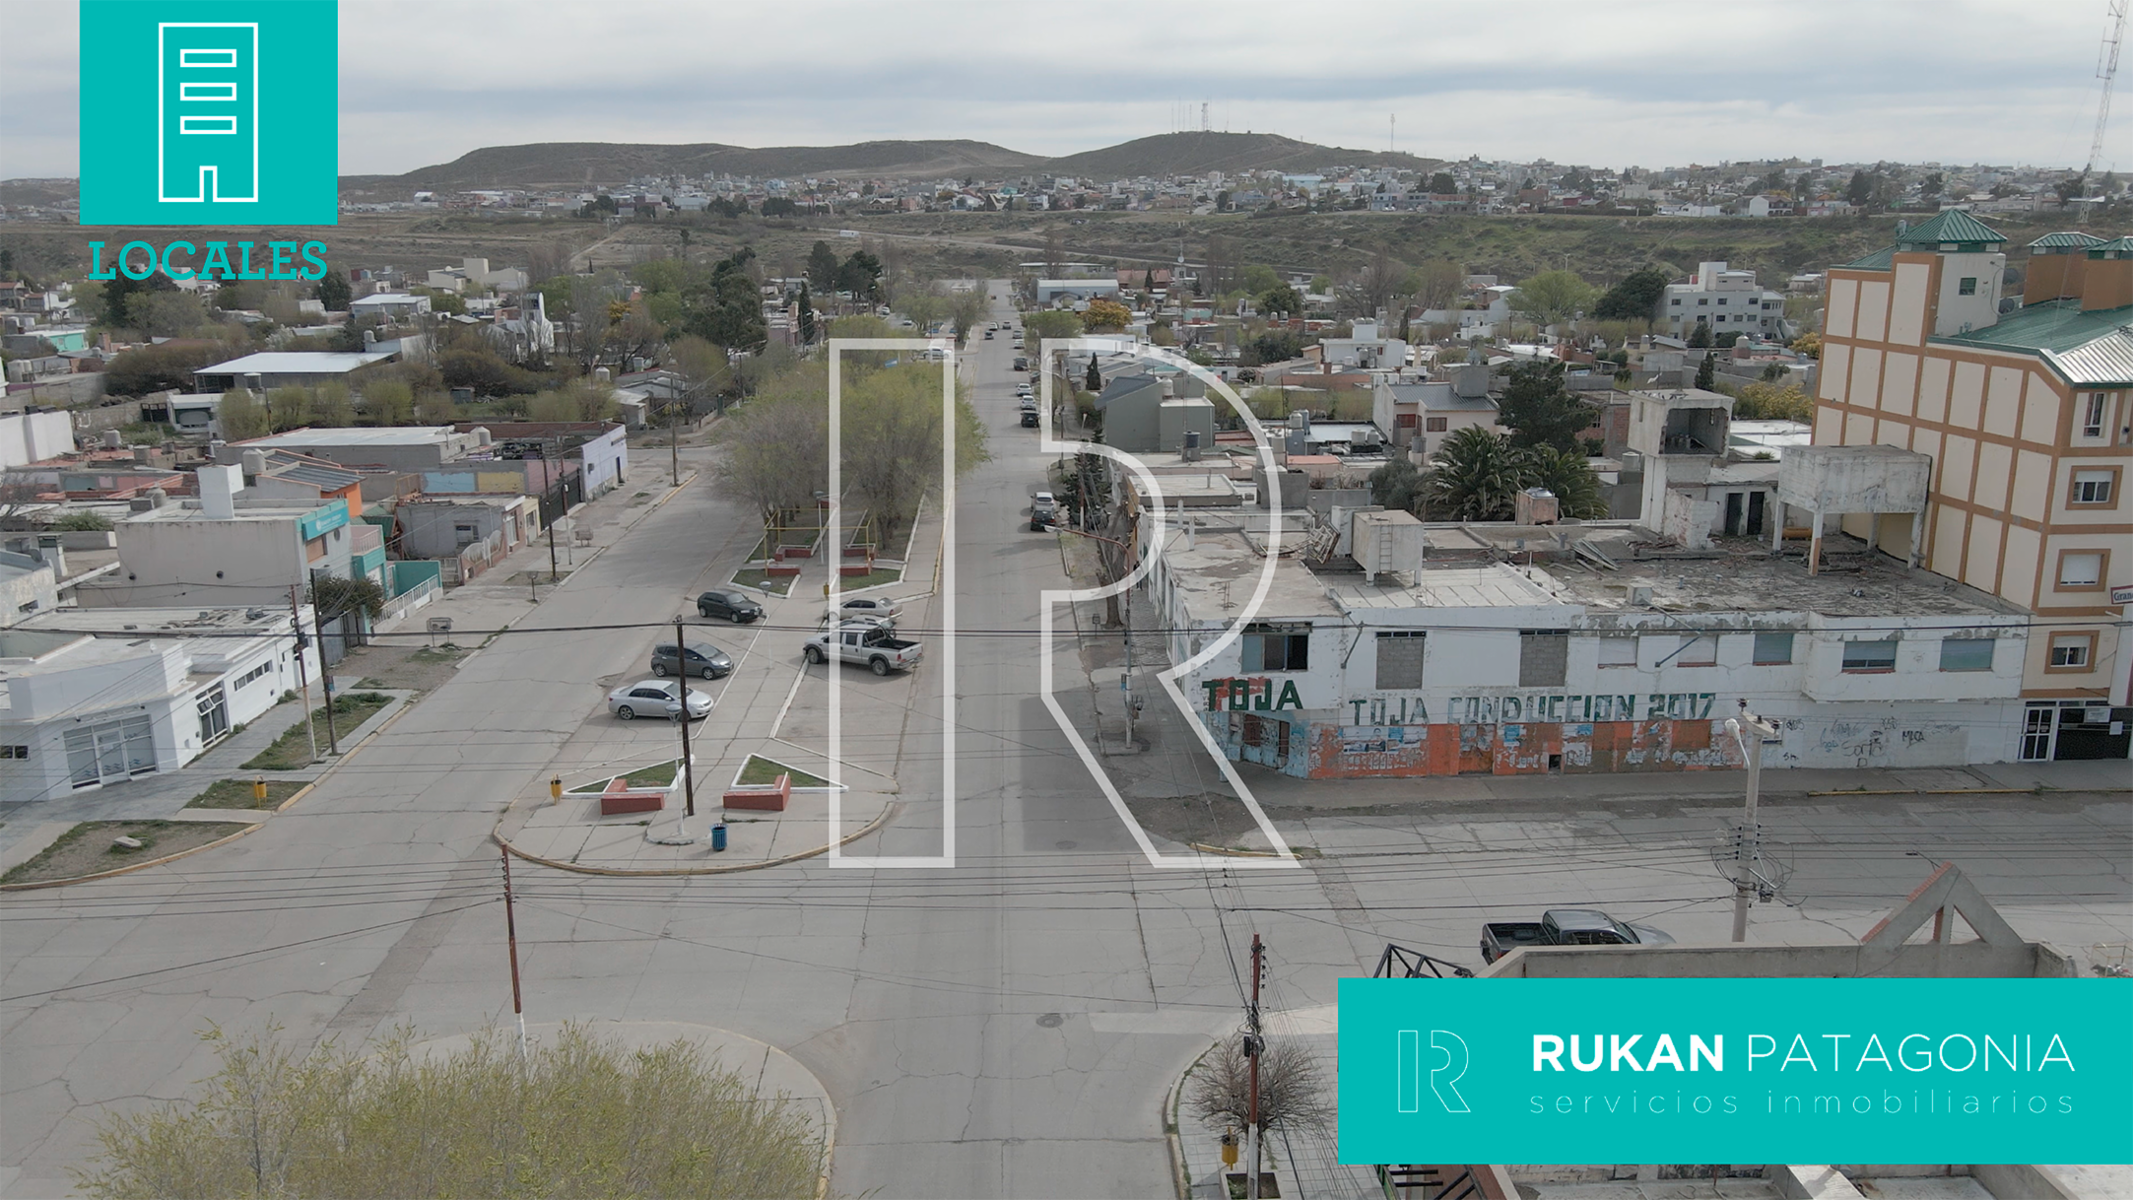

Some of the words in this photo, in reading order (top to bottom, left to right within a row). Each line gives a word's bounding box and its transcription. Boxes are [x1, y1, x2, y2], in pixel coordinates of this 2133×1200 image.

[2113, 591, 2133, 601] Gran
[1202, 679, 1304, 711] TOJA
[1348, 697, 1430, 725] TOJA
[1447, 694, 1636, 724] CONDUCCION
[1648, 693, 1716, 721] 2017
